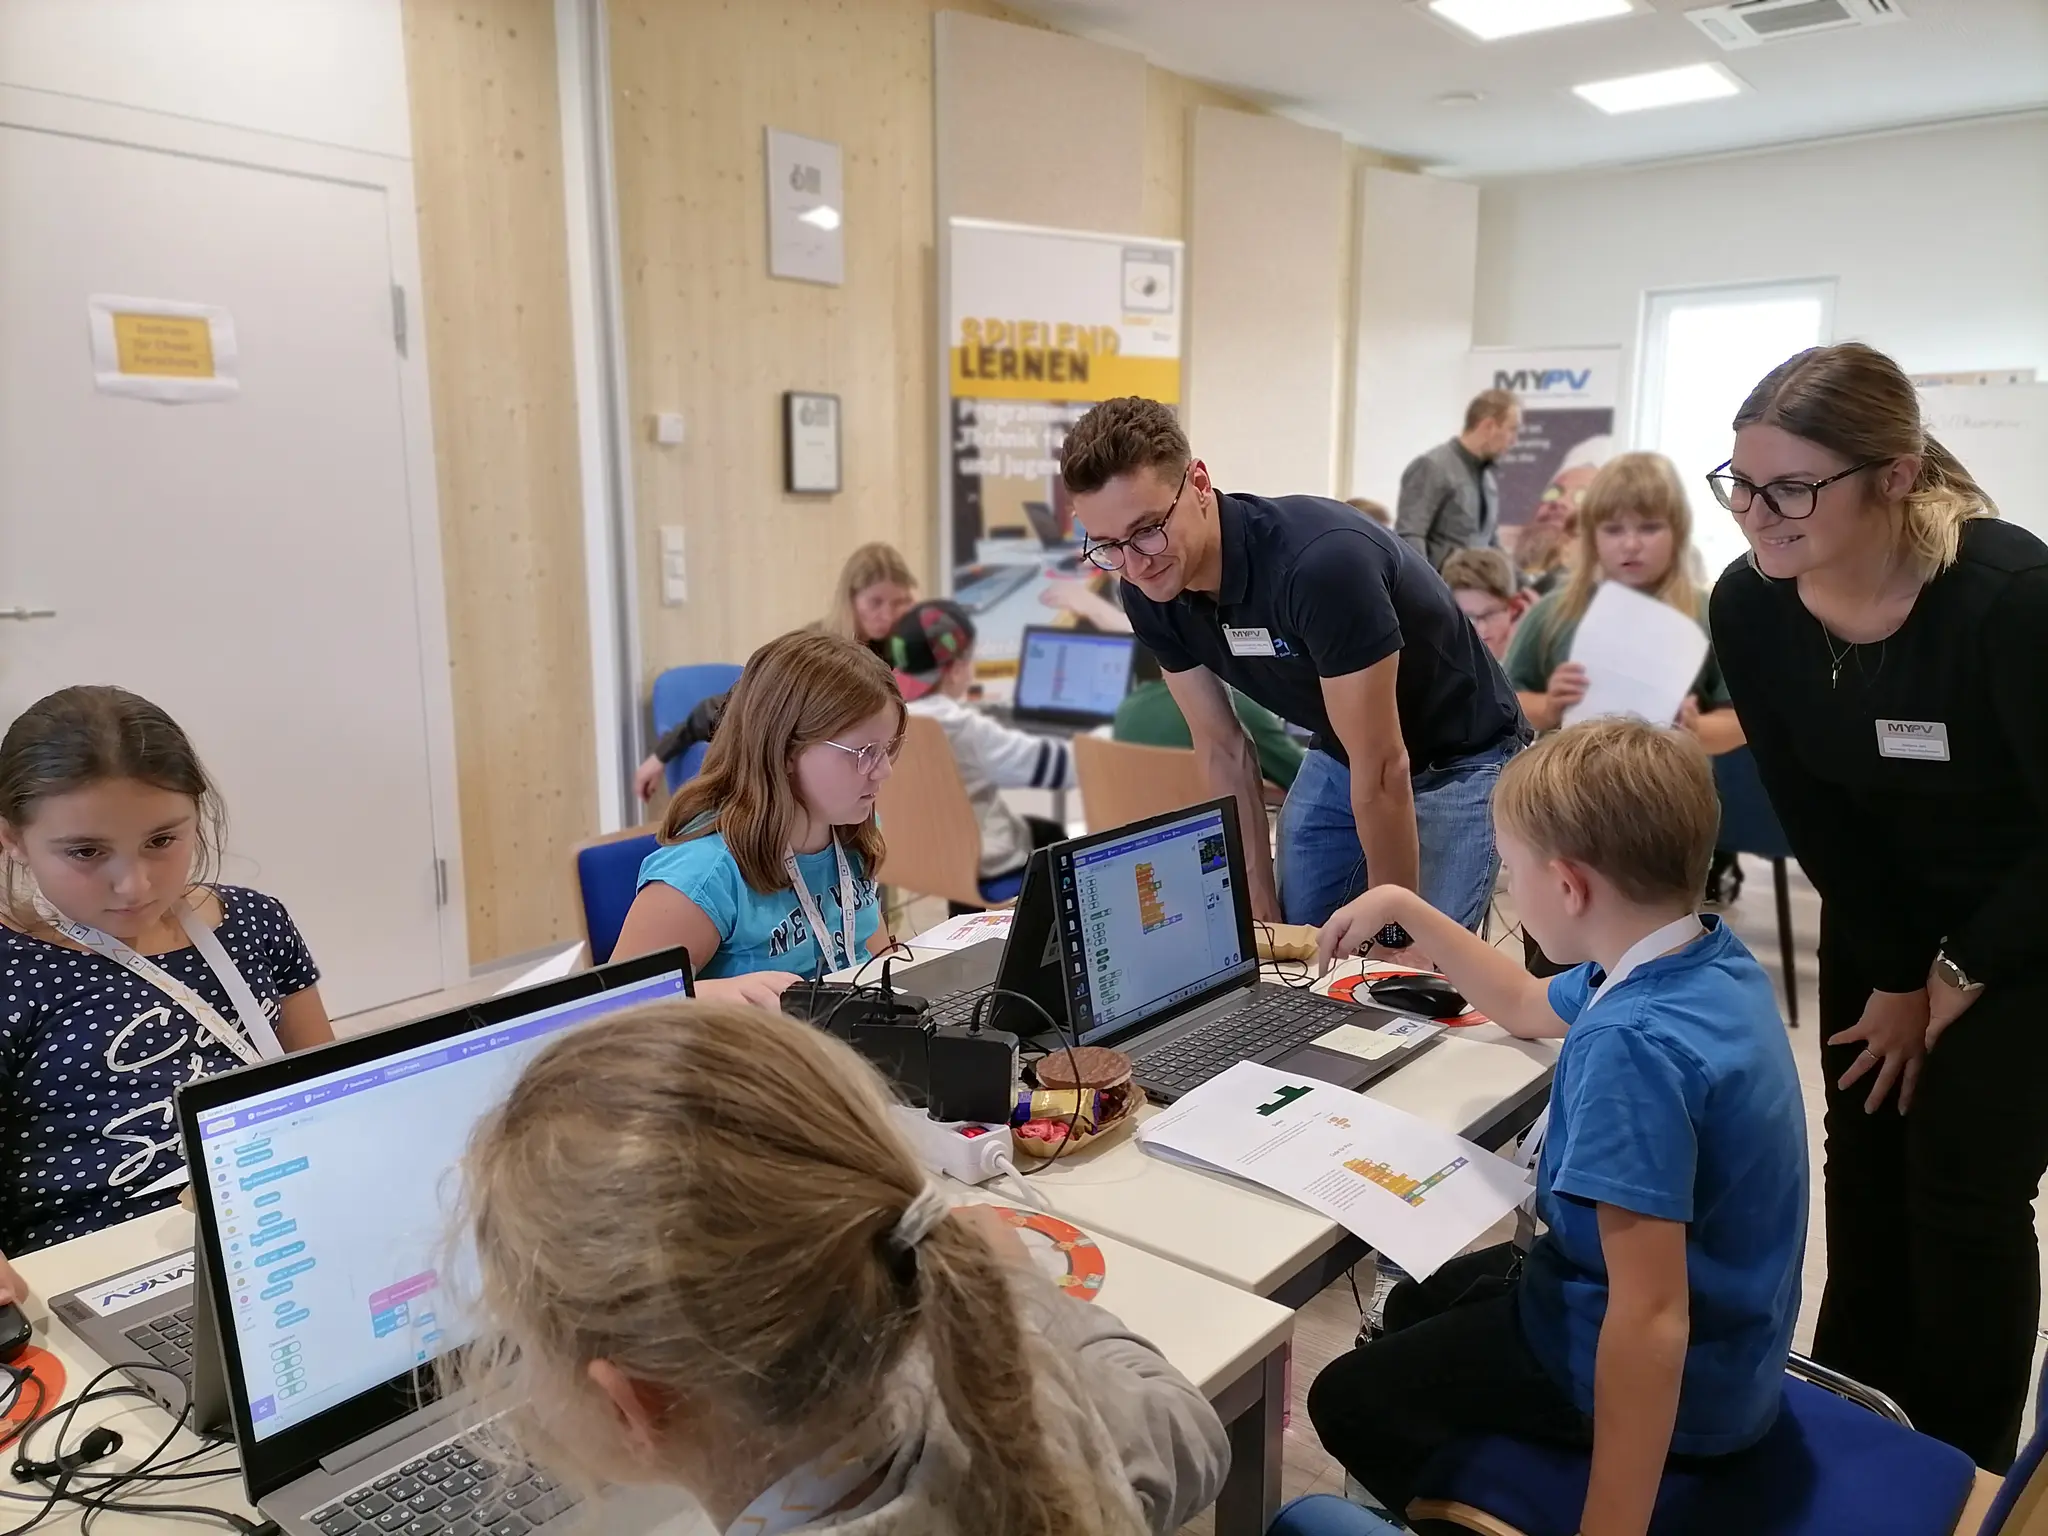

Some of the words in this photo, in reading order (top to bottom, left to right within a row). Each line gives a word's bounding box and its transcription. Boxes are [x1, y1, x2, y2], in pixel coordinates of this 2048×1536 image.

[960, 316, 1120, 356] SPIELEND
[960, 346, 1090, 383] LERNEN
[1493, 368, 1592, 391] MYPV
[1231, 630, 1261, 638] MYPV
[1887, 723, 1934, 734] MYPV
